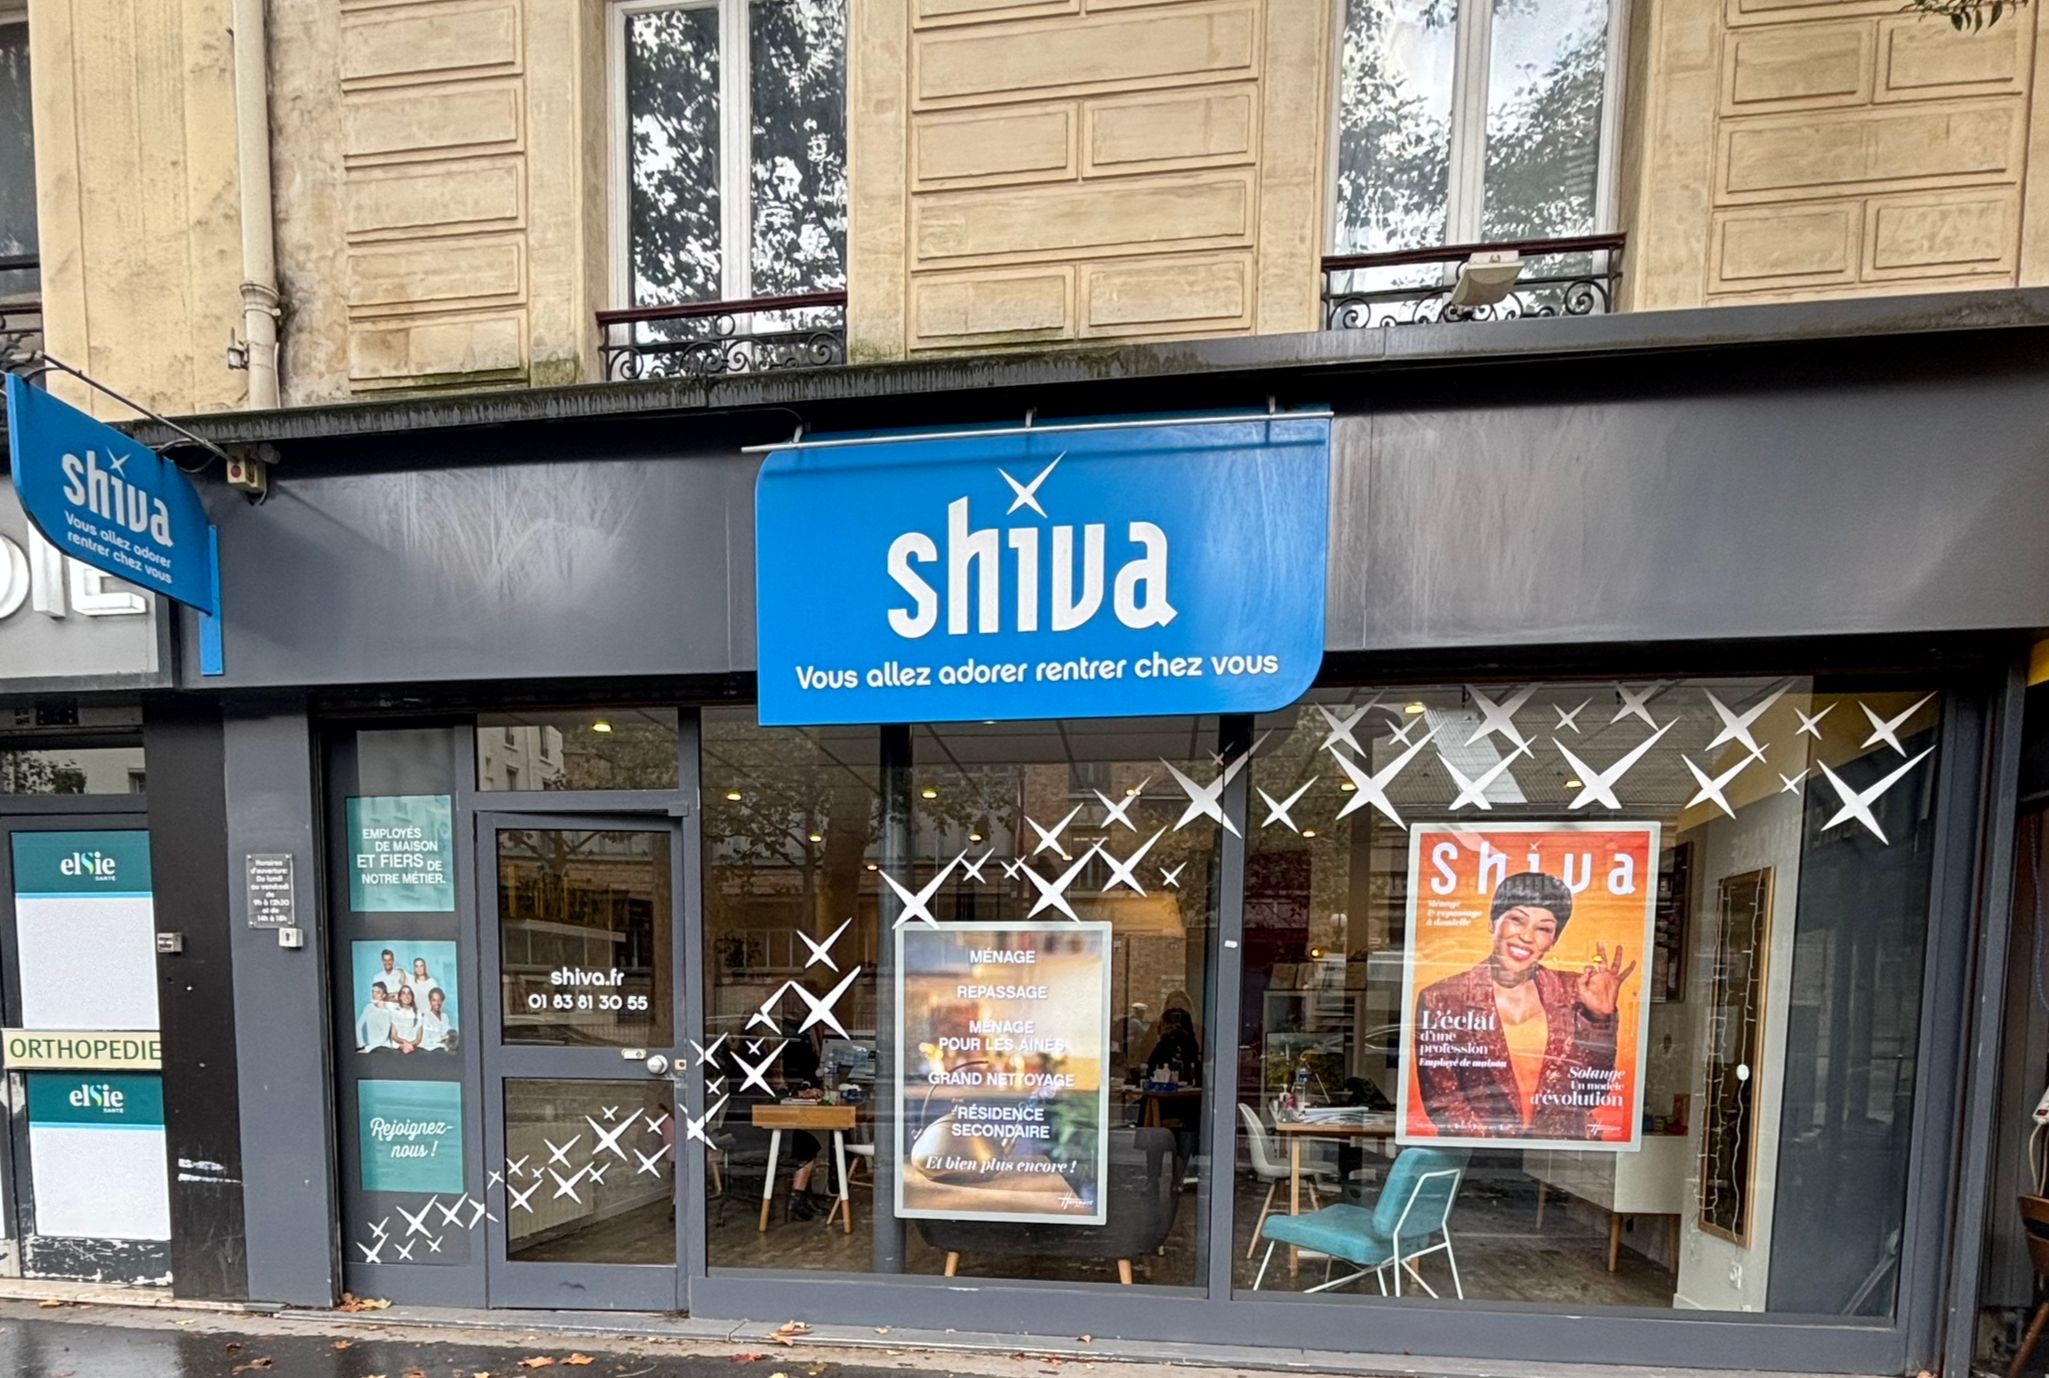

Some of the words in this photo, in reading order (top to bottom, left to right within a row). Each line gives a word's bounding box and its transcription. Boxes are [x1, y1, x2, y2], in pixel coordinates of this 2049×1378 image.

[62, 446, 173, 547] shiva
[64, 510, 97, 536] Vous
[100, 530, 131, 551] allez
[133, 545, 171, 569] adorer
[887, 451, 1177, 638] shiva
[67, 531, 109, 557] rentrer
[112, 551, 142, 571] chez
[144, 564, 172, 584] vous
[795, 665, 858, 690] Vous
[866, 661, 931, 688] allez
[938, 658, 1028, 685] adorer
[1036, 656, 1127, 682] rentrer
[1134, 651, 1203, 678] chez
[1211, 654, 1279, 676] vous
[362, 826, 422, 839] EMPLOYÉS
[375, 841, 391, 852] DE
[393, 840, 438, 851] MAISON
[60, 851, 116, 876] elsie
[357, 853, 376, 868] ET
[380, 853, 424, 868] FIERS
[427, 860, 443, 871] DE
[361, 873, 400, 884] NOTRE
[402, 870, 446, 884] MÉTIER.
[970, 947, 1035, 964] MÉNAGE
[551, 966, 625, 986] shiva.fr
[957, 985, 1048, 999] REPASSAGE
[528, 994, 547, 1009] 01
[553, 994, 573, 1009] 83
[577, 995, 593, 1009] 81
[598, 995, 622, 1010] 30
[627, 995, 648, 1011] 55
[1422, 1009, 1496, 1031] L'éclat
[10, 1038, 161, 1060] ORTHOPEDIE
[939, 1037, 980, 1051] POUR
[985, 1038, 1014, 1051] LES
[1420, 1042, 1488, 1056] profession
[1419, 1058, 1459, 1070] Employé
[1460, 1058, 1471, 1067] de
[928, 1072, 982, 1086] GRAND
[986, 1073, 1075, 1087] NETTOYAGE
[1567, 1066, 1626, 1081] Solange
[1571, 1080, 1585, 1091] Un
[69, 1083, 124, 1107] elsie
[1530, 1090, 1623, 1106] d'évolution
[958, 1104, 1045, 1121] RÉSIDENCE
[370, 1117, 453, 1141] Rejoignez-
[952, 1123, 1050, 1139] SECONDAIRE
[391, 1144, 428, 1158] nous
[431, 1140, 438, 1157] !
[926, 1156, 942, 1169] Et
[945, 1157, 977, 1171] bien
[980, 1157, 1014, 1174] plus
[1017, 1160, 1067, 1174] encore
[1069, 1160, 1077, 1173] !
